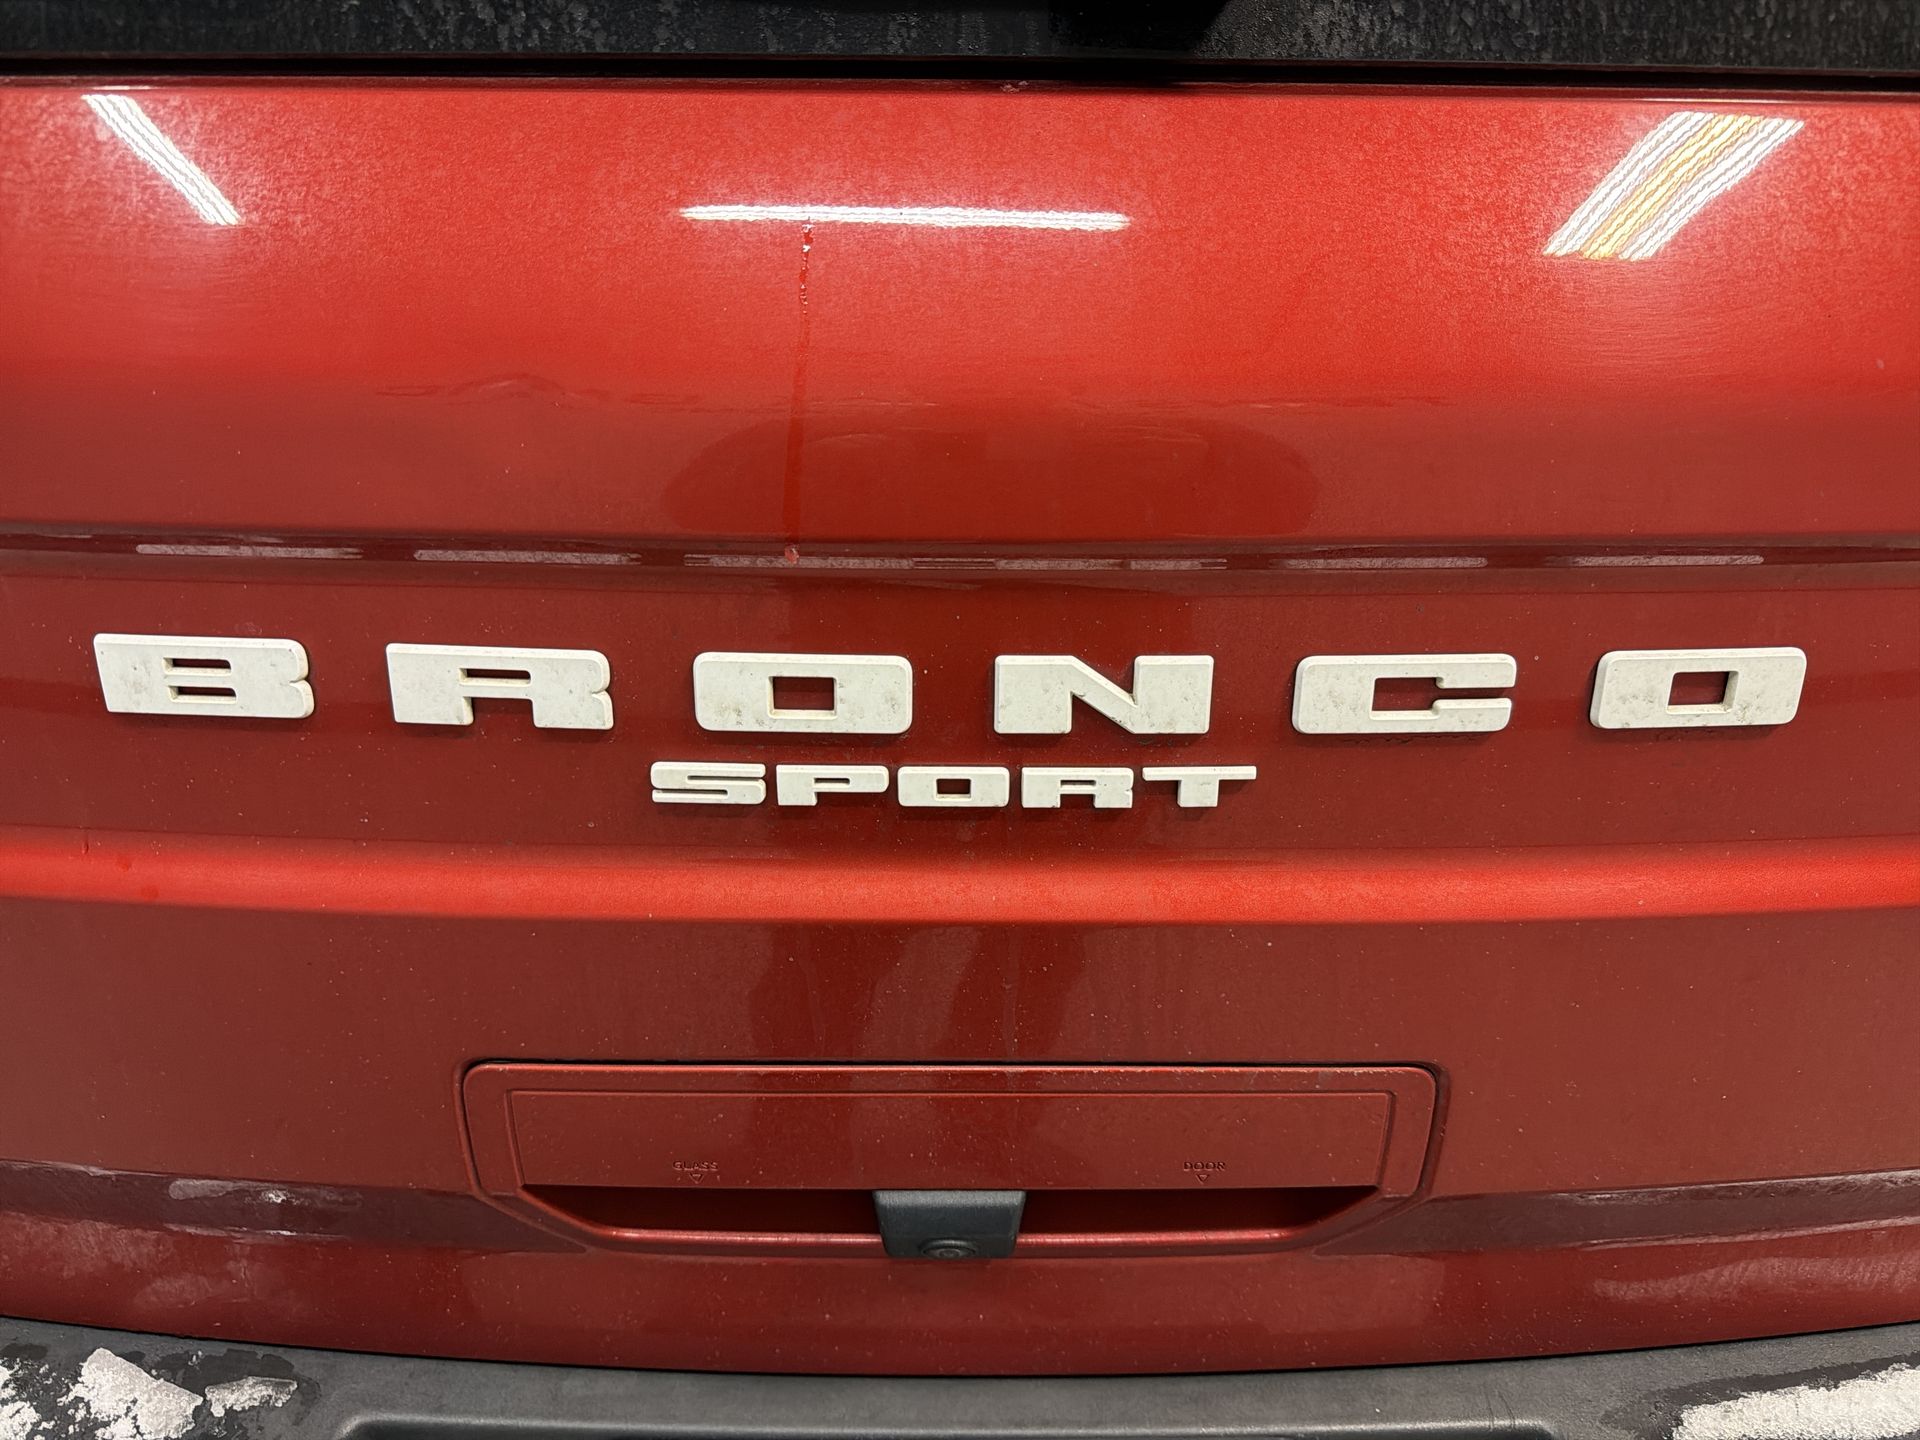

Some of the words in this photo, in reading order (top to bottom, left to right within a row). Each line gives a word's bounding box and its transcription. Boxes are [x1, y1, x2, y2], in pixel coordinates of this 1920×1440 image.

[93, 633, 1807, 735] BRONCO
[650, 761, 1257, 808] SPORT
[672, 1160, 719, 1171] GLASS
[1183, 1161, 1226, 1171] DOOR
